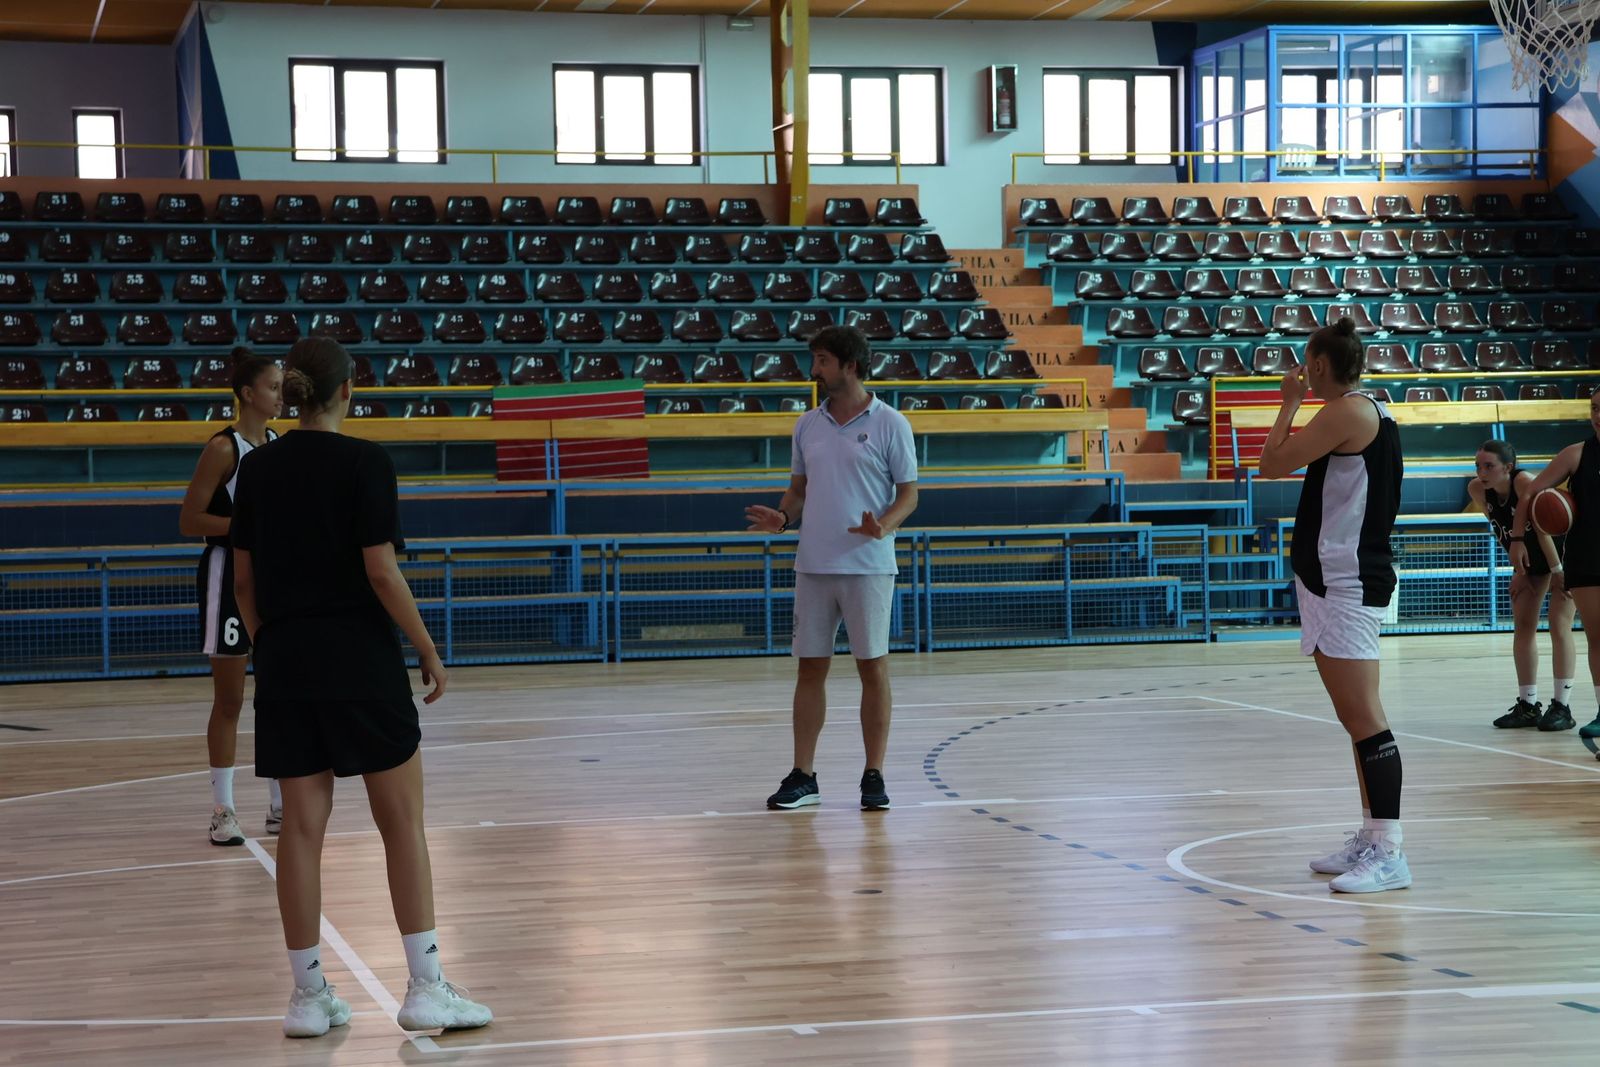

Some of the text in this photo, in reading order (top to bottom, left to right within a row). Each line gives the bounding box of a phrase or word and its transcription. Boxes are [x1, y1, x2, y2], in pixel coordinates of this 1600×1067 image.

[347, 198, 359, 208] 41
[569, 198, 583, 208] 49
[1436, 198, 1447, 206] 79
[360, 234, 373, 245] 41
[532, 236, 547, 246] 47
[916, 236, 926, 245] 61
[960, 257, 995, 268] FILA
[374, 275, 387, 286] 41
[550, 275, 562, 283] 47
[945, 274, 958, 283] 61
[972, 275, 1007, 287] FILA
[570, 313, 585, 322] 47
[973, 310, 984, 320] 61
[4, 316, 20, 326] 29
[8, 362, 25, 371] 29
[401, 358, 415, 368] 41
[1099, 394, 1106, 403] 2
[420, 405, 435, 414] 41
[674, 402, 689, 411] 49
[12, 408, 30, 420] 29
[224, 616, 239, 646] 6
